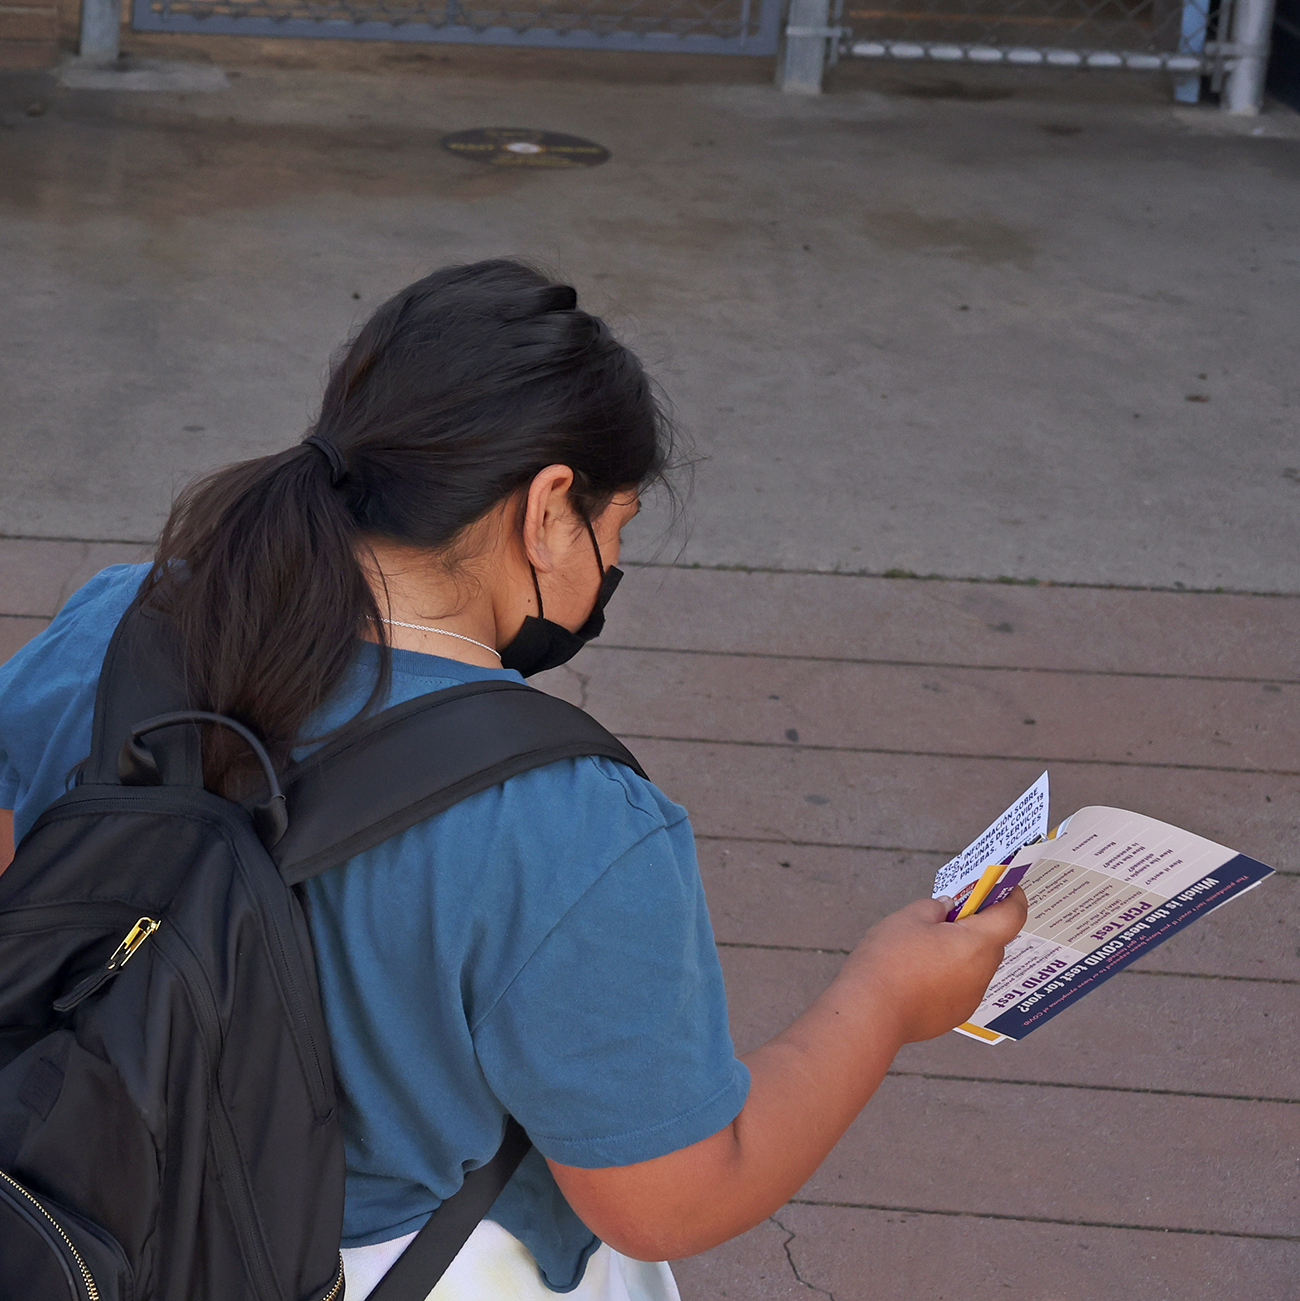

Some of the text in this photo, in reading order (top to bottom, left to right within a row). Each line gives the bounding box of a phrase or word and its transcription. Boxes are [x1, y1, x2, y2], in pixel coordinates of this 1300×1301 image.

[959, 792, 1044, 872] VACUNAS DEL COVID-19
[963, 787, 1039, 861] INFORMACIÓN SOBRE
[1005, 802, 1044, 841] SERVICIOS
[1005, 813, 1042, 849] SOCIALES
[1094, 842, 1116, 856] Results
[1091, 901, 1152, 940] PCR Test
[1017, 878, 1218, 1012] Which is the best COVID test for you?
[992, 960, 1066, 1007] RAPID Test
